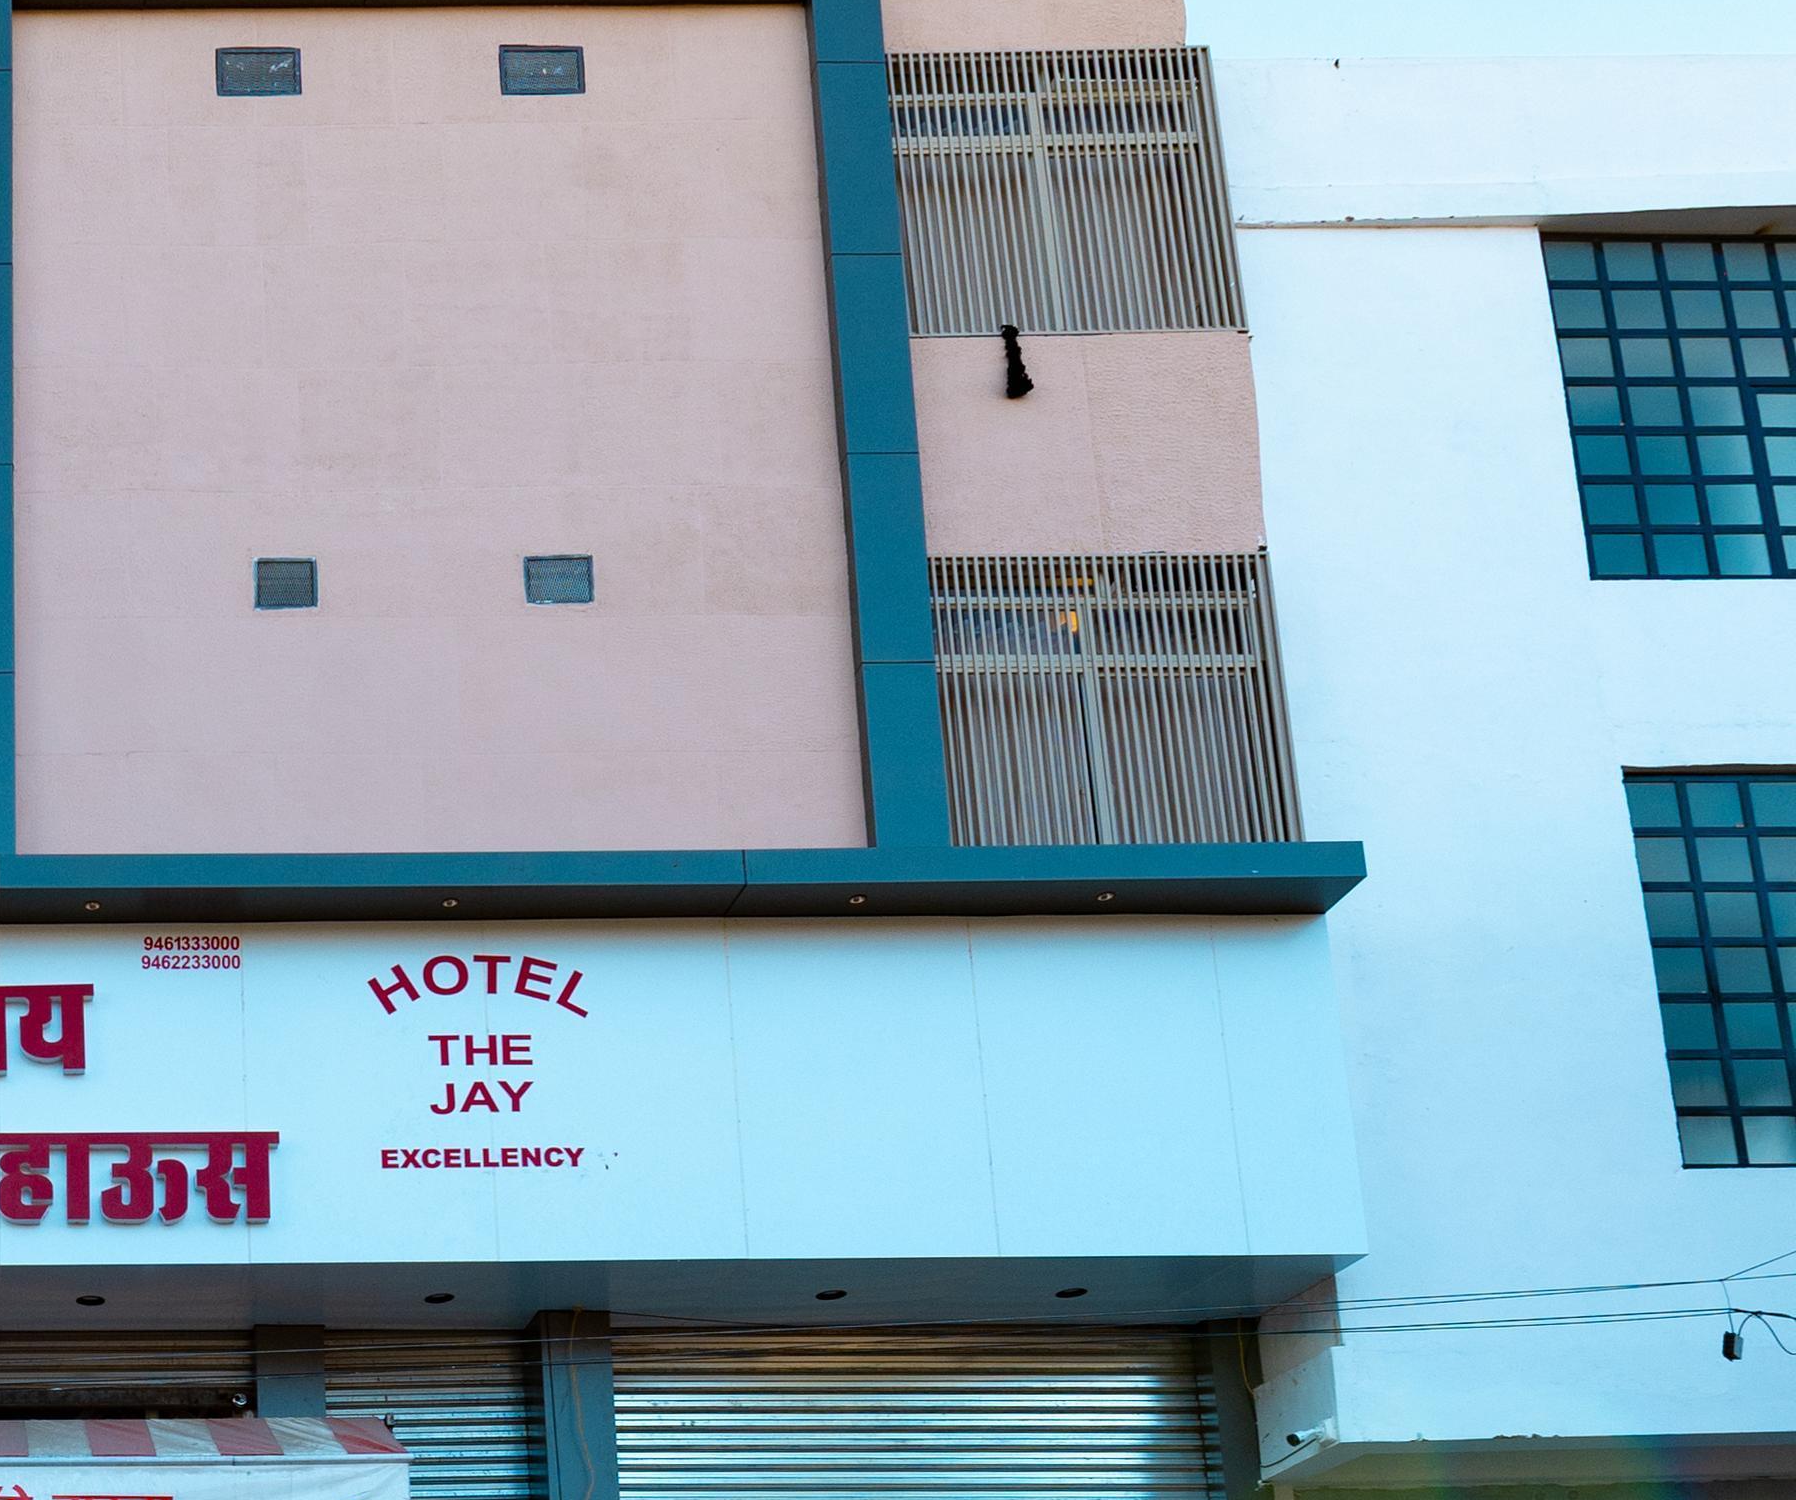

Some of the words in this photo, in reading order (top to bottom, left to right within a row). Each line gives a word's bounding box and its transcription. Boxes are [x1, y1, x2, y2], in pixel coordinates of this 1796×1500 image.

[144, 936, 240, 951] 9461333000
[141, 955, 241, 969] 9462233000
[367, 954, 589, 1018] HOTEL
[428, 1034, 533, 1066] THE
[430, 1080, 534, 1115] JAY
[381, 1147, 585, 1169] EXCELLENCY
